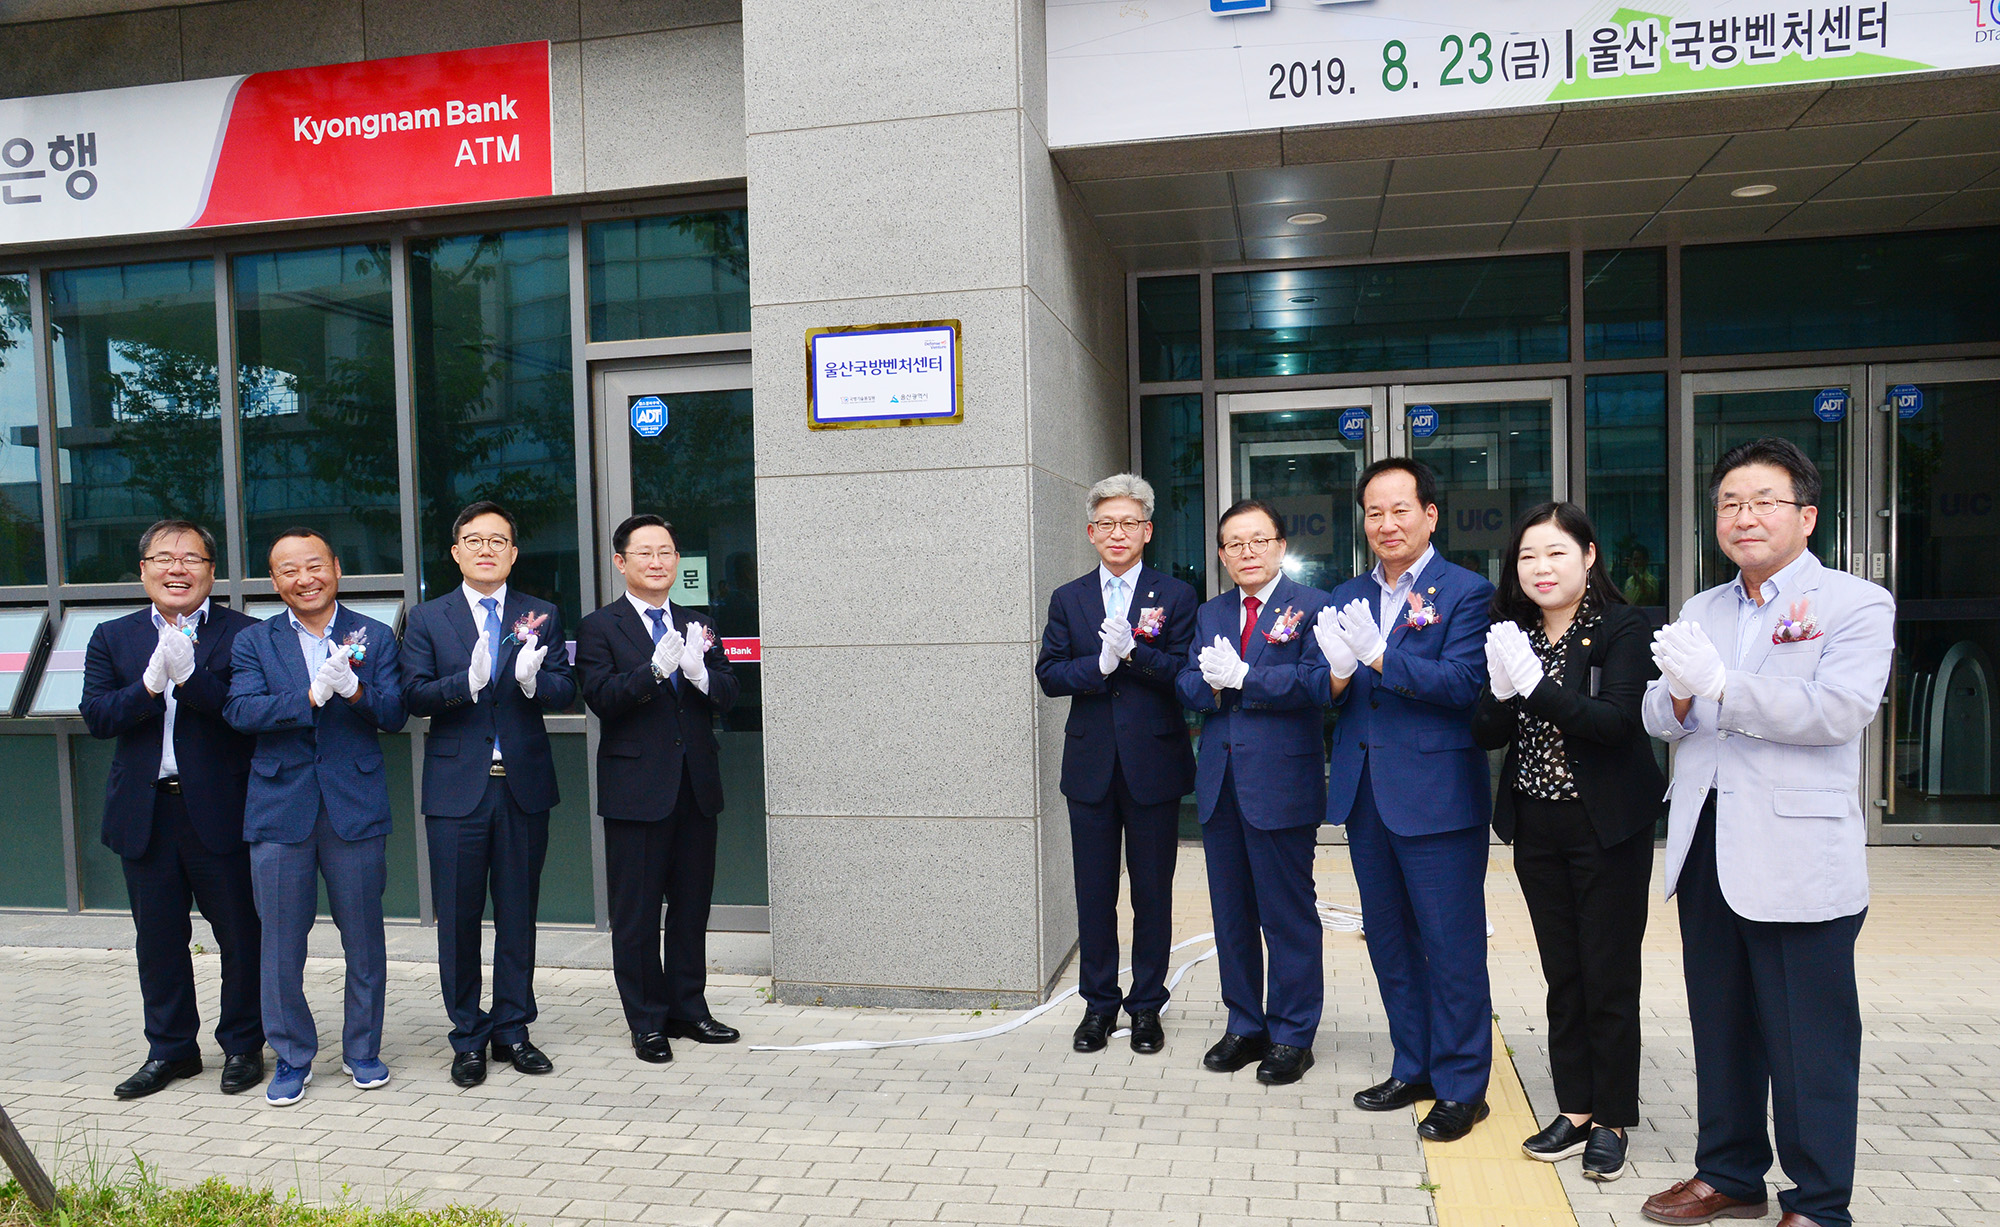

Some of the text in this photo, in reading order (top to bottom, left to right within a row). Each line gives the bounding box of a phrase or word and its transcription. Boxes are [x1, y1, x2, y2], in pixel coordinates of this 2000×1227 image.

[1269, 57, 1355, 100] 2019.
[1382, 39, 1418, 92] 8.
[1589, 24, 1658, 73] 울산
[1671, 1, 1887, 65] 국방벤처센터
[293, 94, 518, 145] Kyongnam Bank
[454, 134, 520, 167] ATM
[0, 132, 98, 205] 은행
[824, 355, 942, 379] 울산국방벤처센터
[637, 408, 662, 424] ADT
[1819, 398, 1844, 411] ADT
[1344, 418, 1364, 430] ADT
[1413, 415, 1434, 427] ADT
[1456, 507, 1503, 532] UIC
[731, 647, 752, 655] Bank
